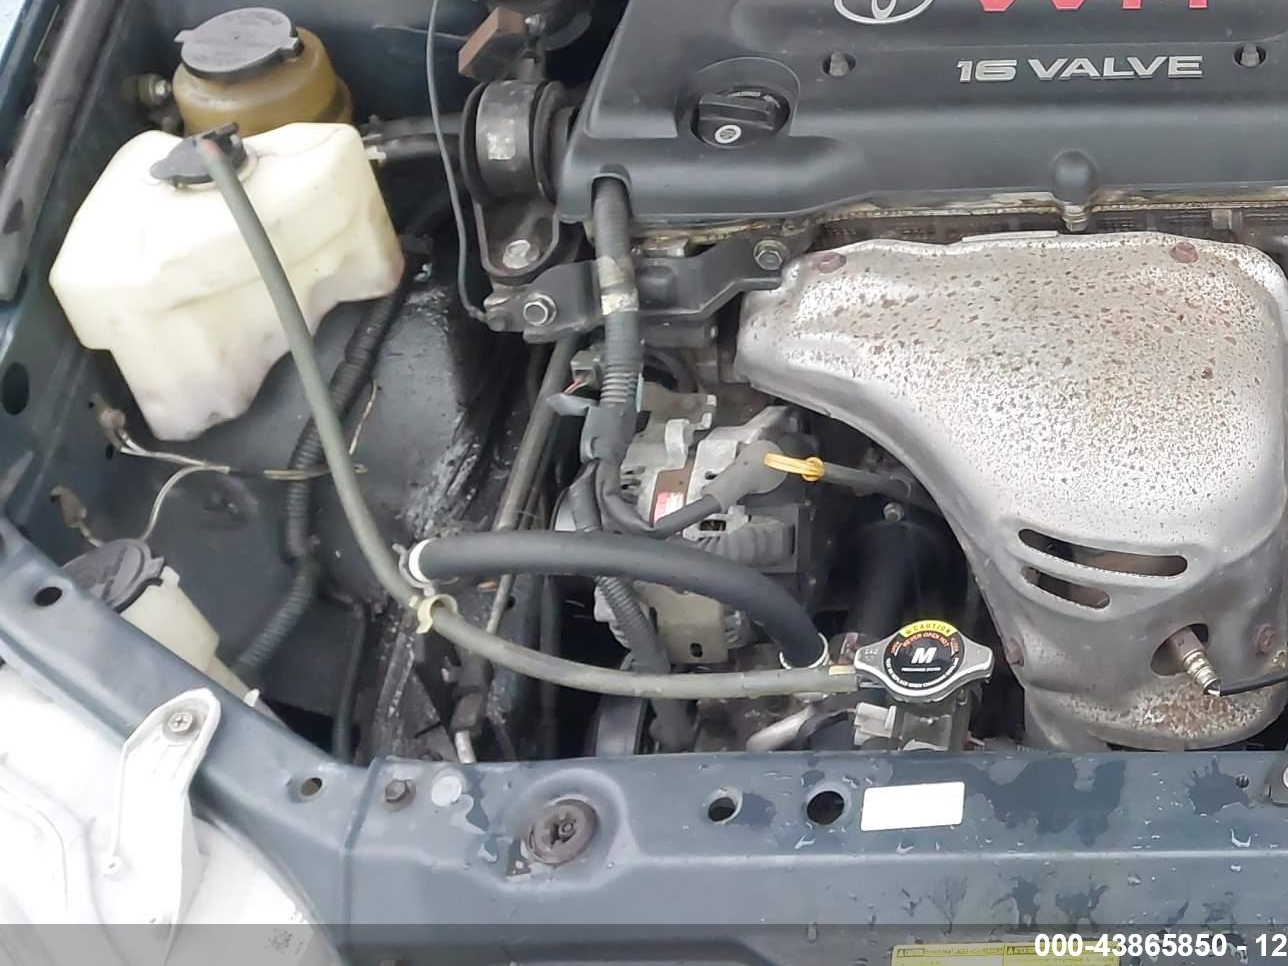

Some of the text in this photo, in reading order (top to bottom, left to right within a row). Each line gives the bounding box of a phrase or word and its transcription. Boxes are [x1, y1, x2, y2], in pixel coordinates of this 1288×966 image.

[956, 55, 1203, 82] 16 VALVE
[913, 623, 951, 634] CAUTION
